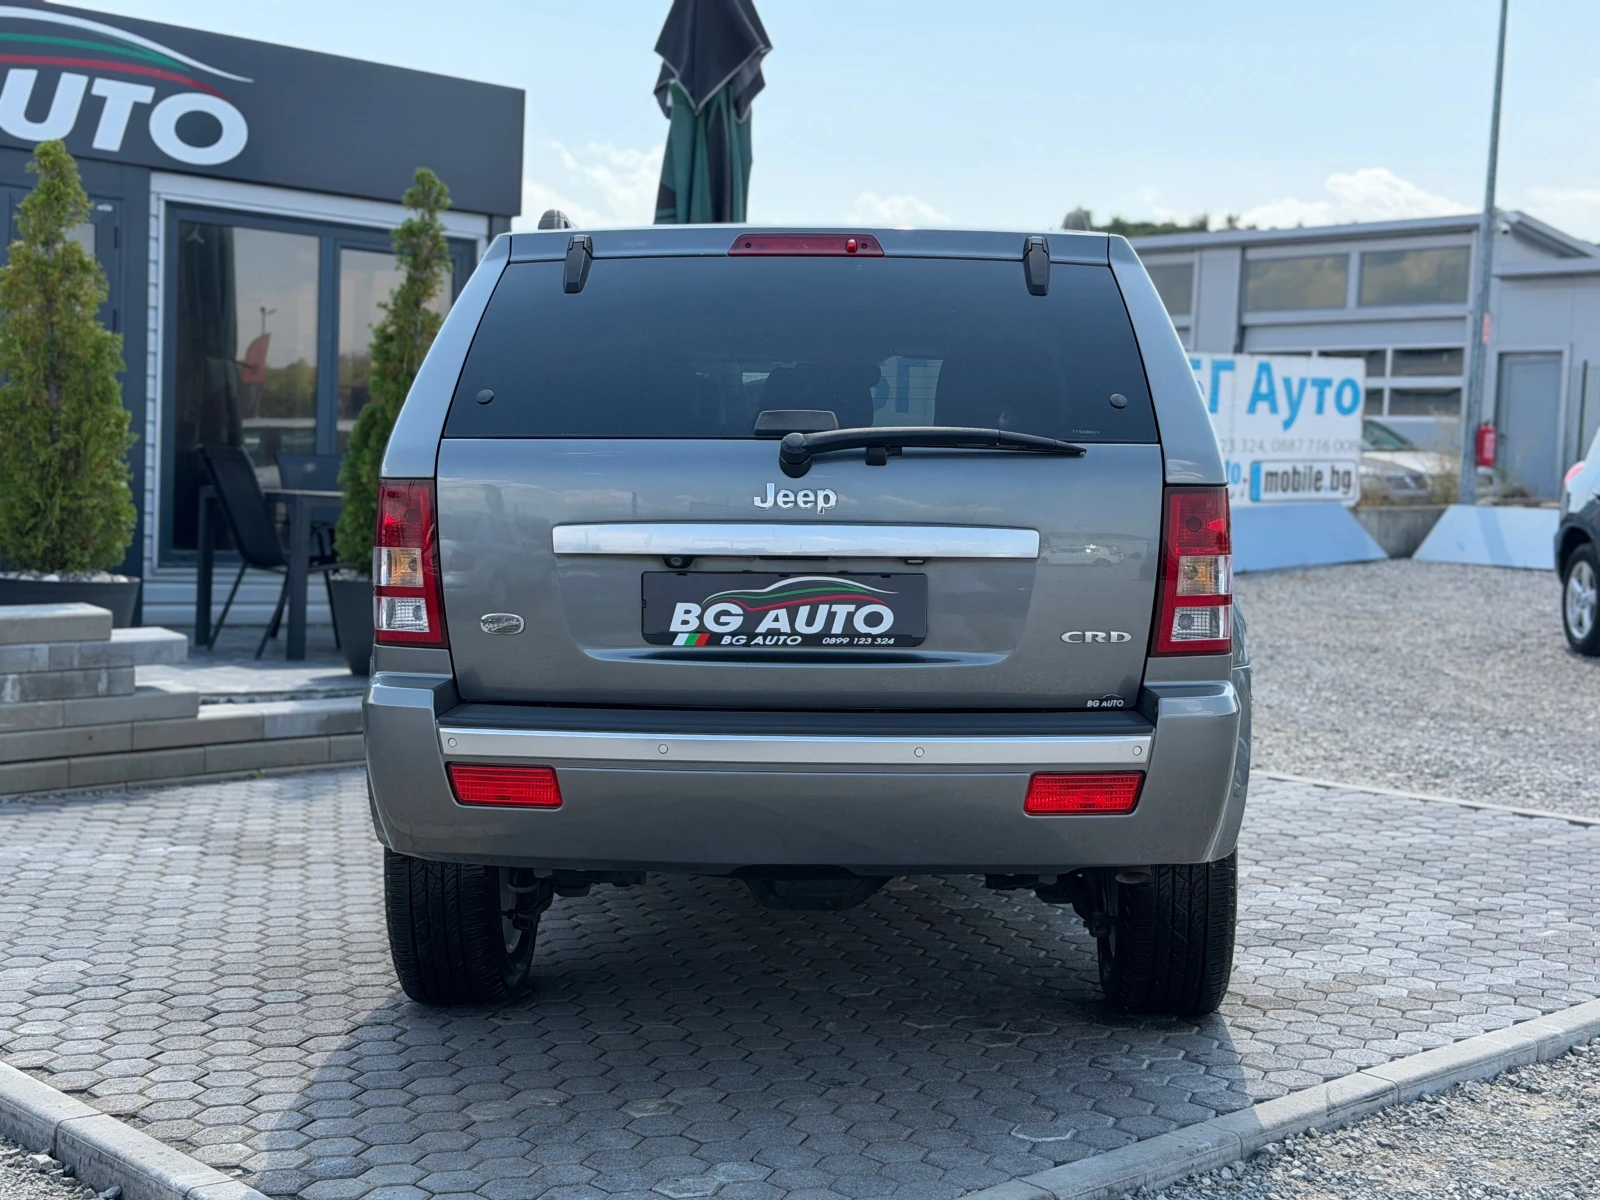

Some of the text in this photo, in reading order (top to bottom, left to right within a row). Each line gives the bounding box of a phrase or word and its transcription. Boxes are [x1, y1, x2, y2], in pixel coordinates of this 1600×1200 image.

[1246, 361, 1361, 432] Ауто
[1263, 465, 1352, 495] mobile.bg
[753, 482, 837, 514] Jeep
[669, 602, 894, 635] BG AUTO
[720, 635, 802, 646] BG AUTO
[822, 637, 895, 645] 0899 123 324
[1060, 630, 1132, 644] CRD
[1086, 699, 1124, 708] BG AUTO
